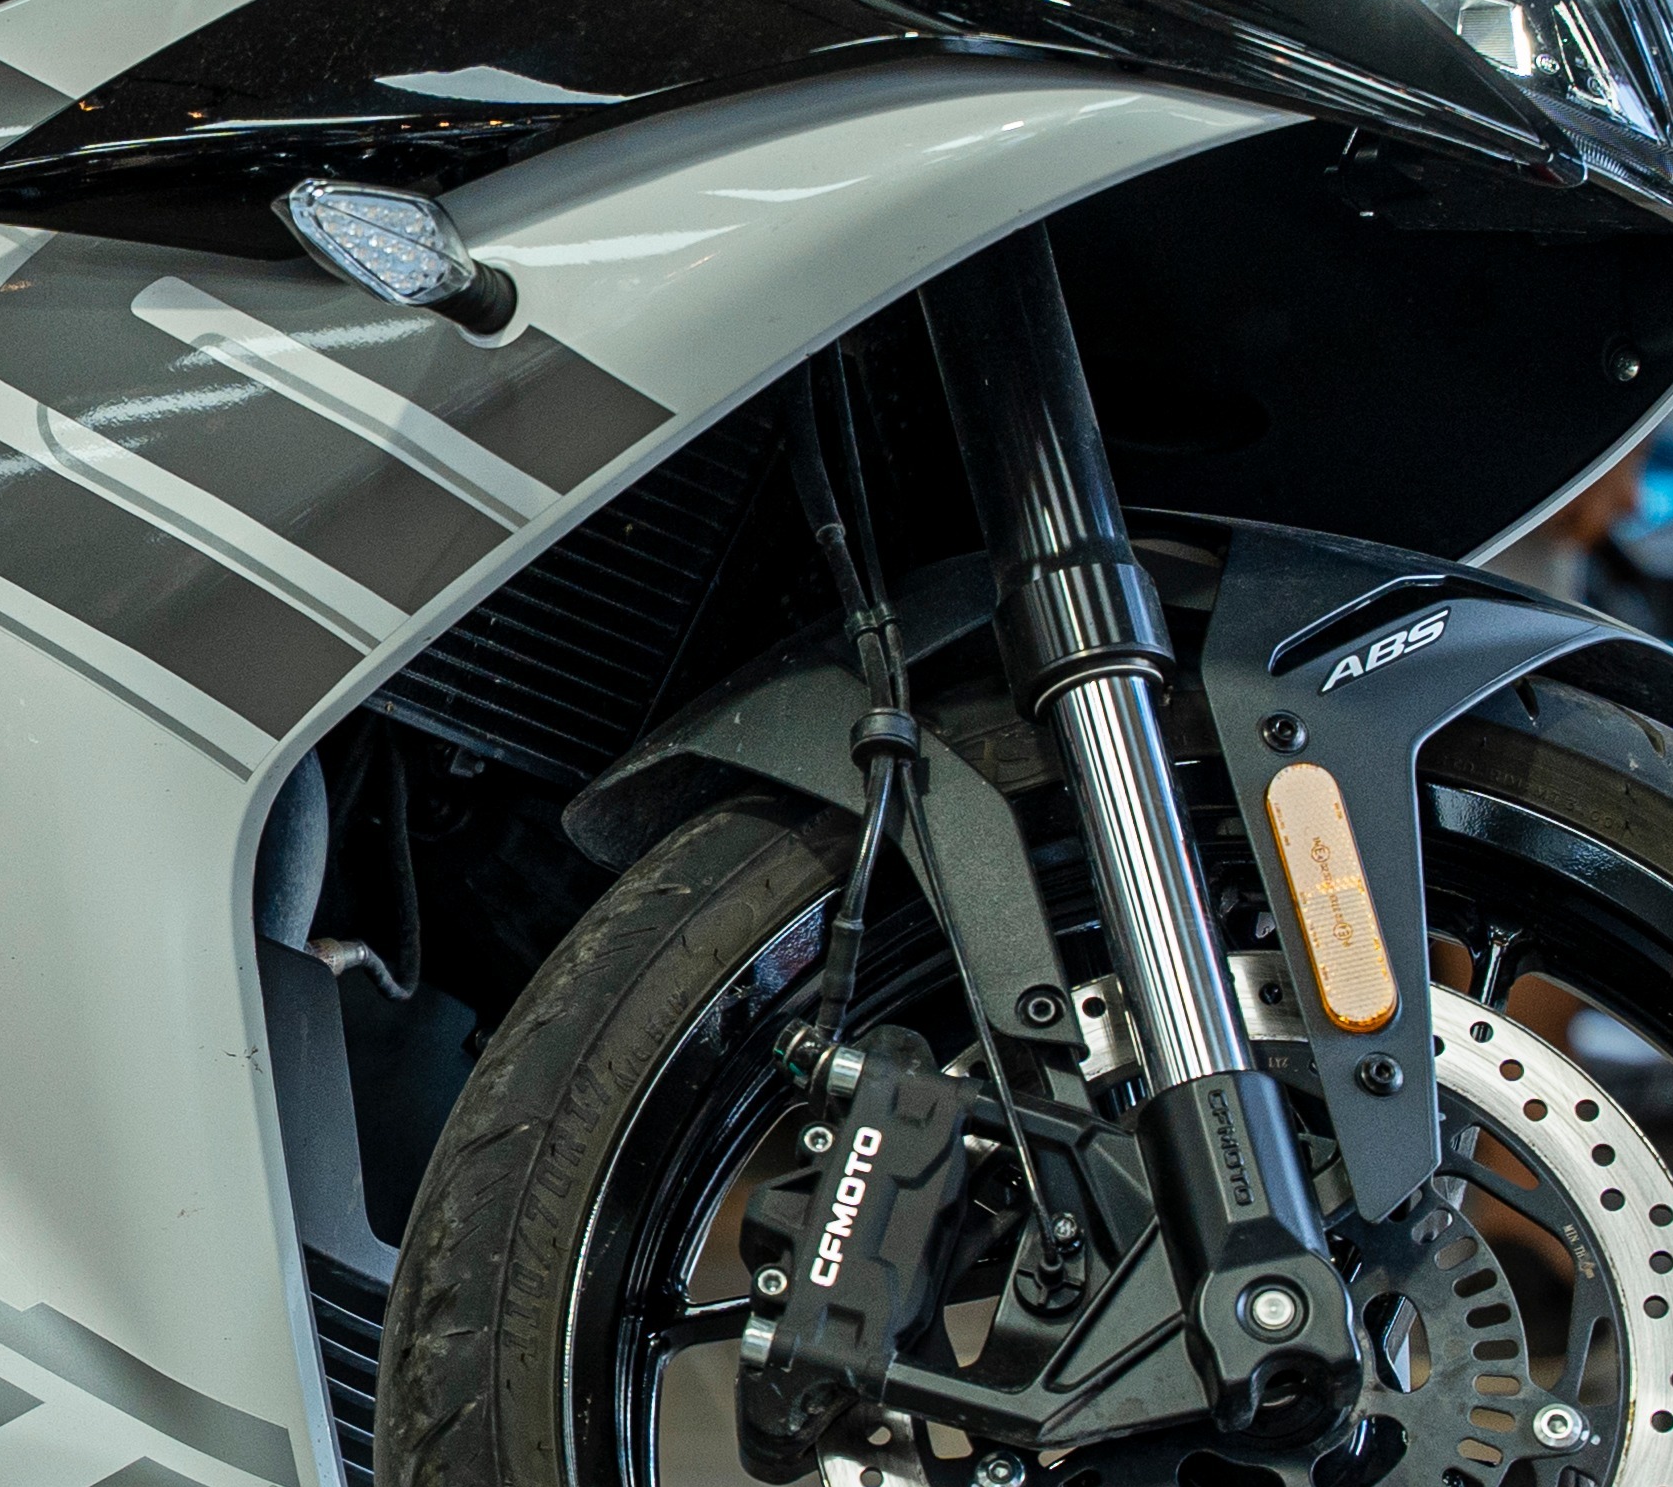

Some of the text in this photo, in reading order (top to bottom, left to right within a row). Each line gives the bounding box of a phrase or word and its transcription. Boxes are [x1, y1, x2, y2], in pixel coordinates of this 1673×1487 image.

[1321, 609, 1449, 693] ABS
[809, 1126, 883, 1288] CFMOTO
[1207, 1088, 1255, 1208] CFMOTO
